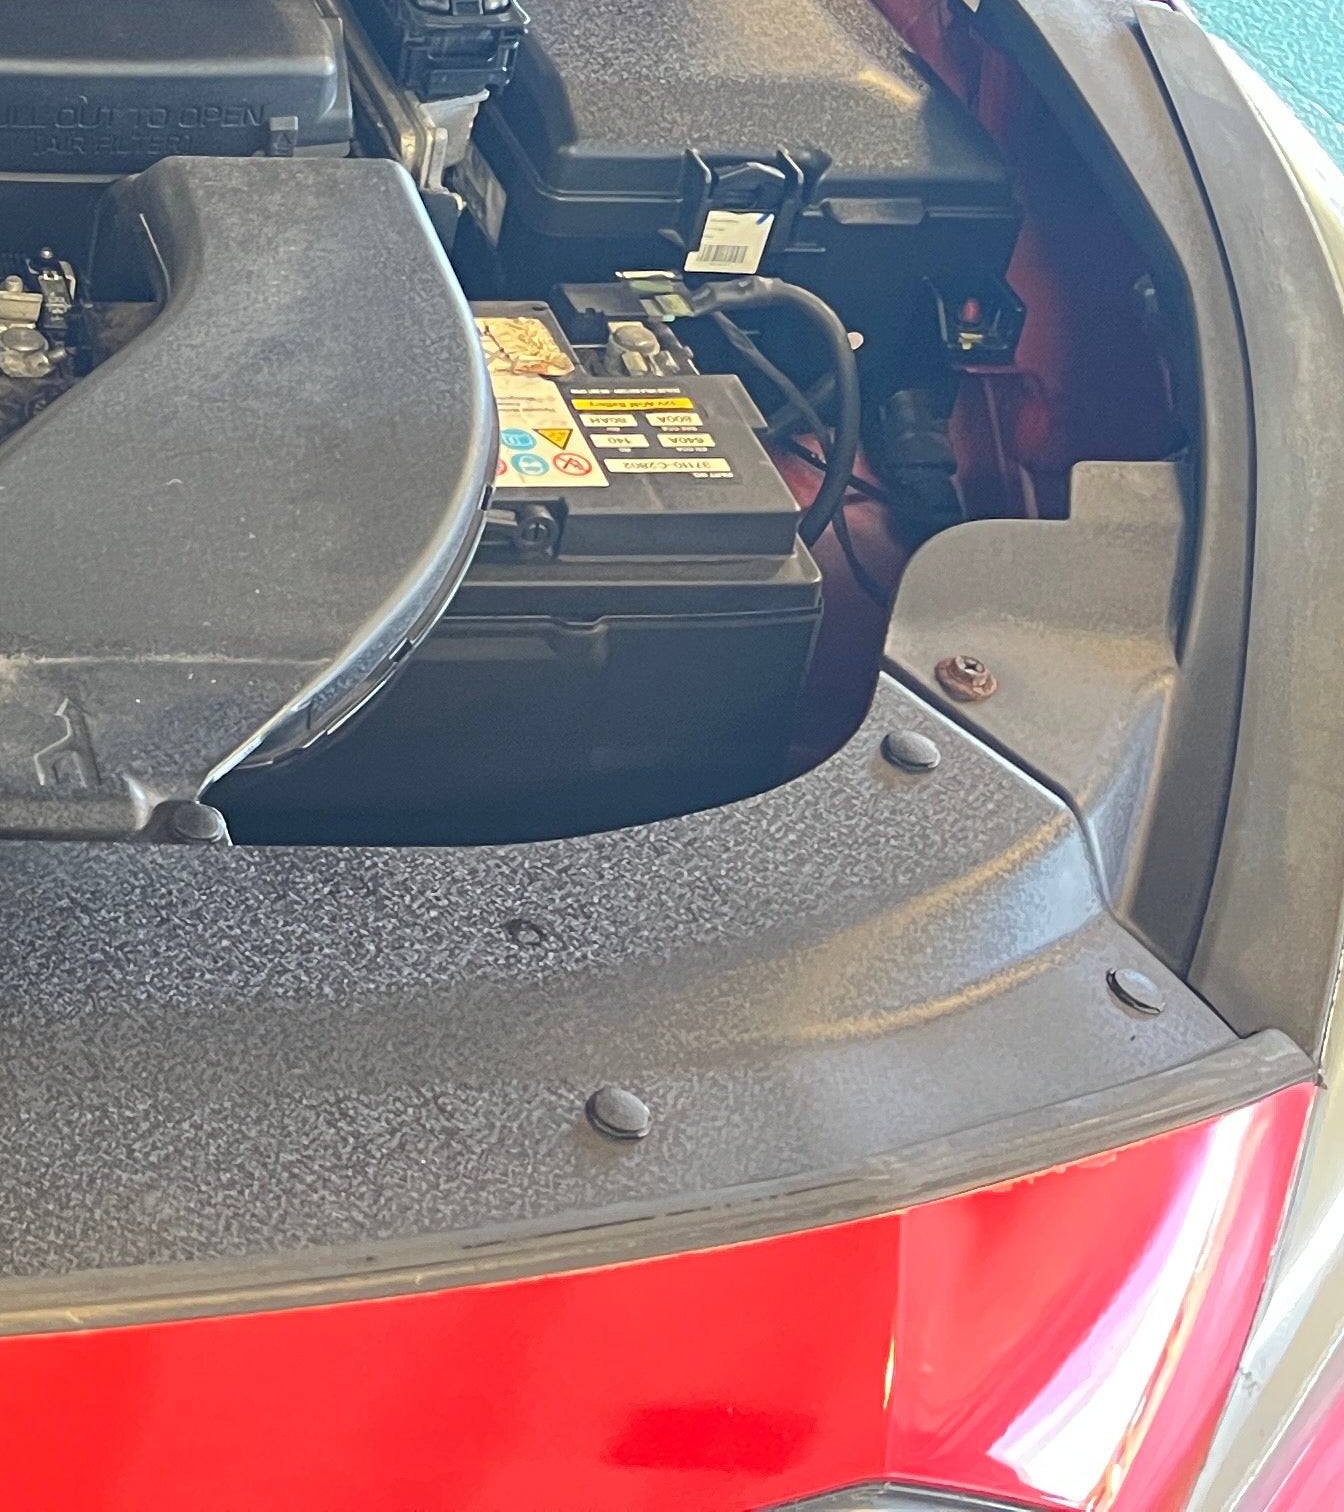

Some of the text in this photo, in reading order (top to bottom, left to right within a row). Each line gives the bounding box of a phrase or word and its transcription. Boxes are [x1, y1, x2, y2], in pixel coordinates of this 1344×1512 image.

[54, 106, 114, 129] OUT
[126, 106, 168, 129] TO
[177, 105, 263, 128] OPEN
